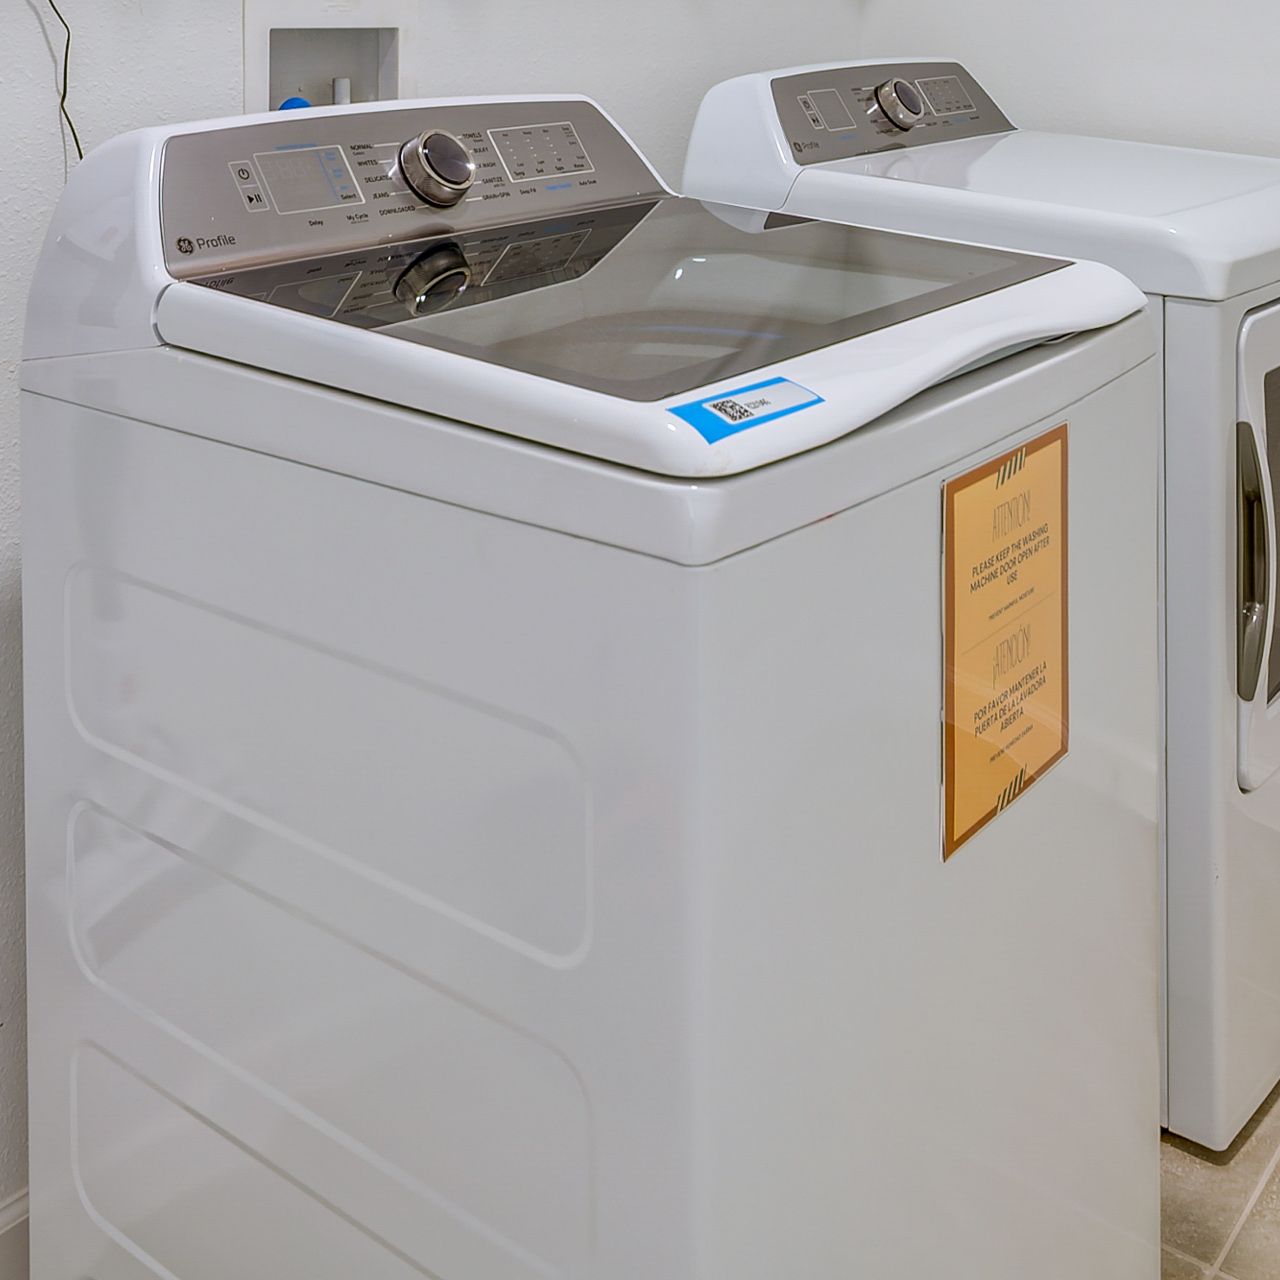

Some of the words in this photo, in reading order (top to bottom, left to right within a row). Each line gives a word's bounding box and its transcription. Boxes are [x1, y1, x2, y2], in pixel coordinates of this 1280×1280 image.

[350, 143, 373, 151] NORMAL
[357, 159, 379, 167] WHITES
[372, 192, 390, 200] JEANS
[378, 205, 417, 217] DOWNLOADED
[196, 234, 236, 250] Profile
[992, 489, 1031, 543] ATTENTION!
[972, 556, 995, 578] PLEASE
[995, 546, 1010, 563] KEEP
[1011, 539, 1022, 552] THE
[1022, 523, 1049, 547] WASHING
[970, 567, 999, 594] MACHINE
[1000, 557, 1017, 576] DOOR
[1018, 547, 1034, 564] OPEN
[1033, 536, 1050, 553] AFTER
[1006, 570, 1018, 585] USE
[974, 705, 988, 723] POR
[987, 690, 1009, 713] FAVOR
[1009, 666, 1040, 697] MANTENER
[975, 712, 999, 738] PUERTA
[999, 704, 1008, 719] DE
[1016, 675, 1046, 706] LAVADORA
[1000, 707, 1024, 732] ABIERTA
